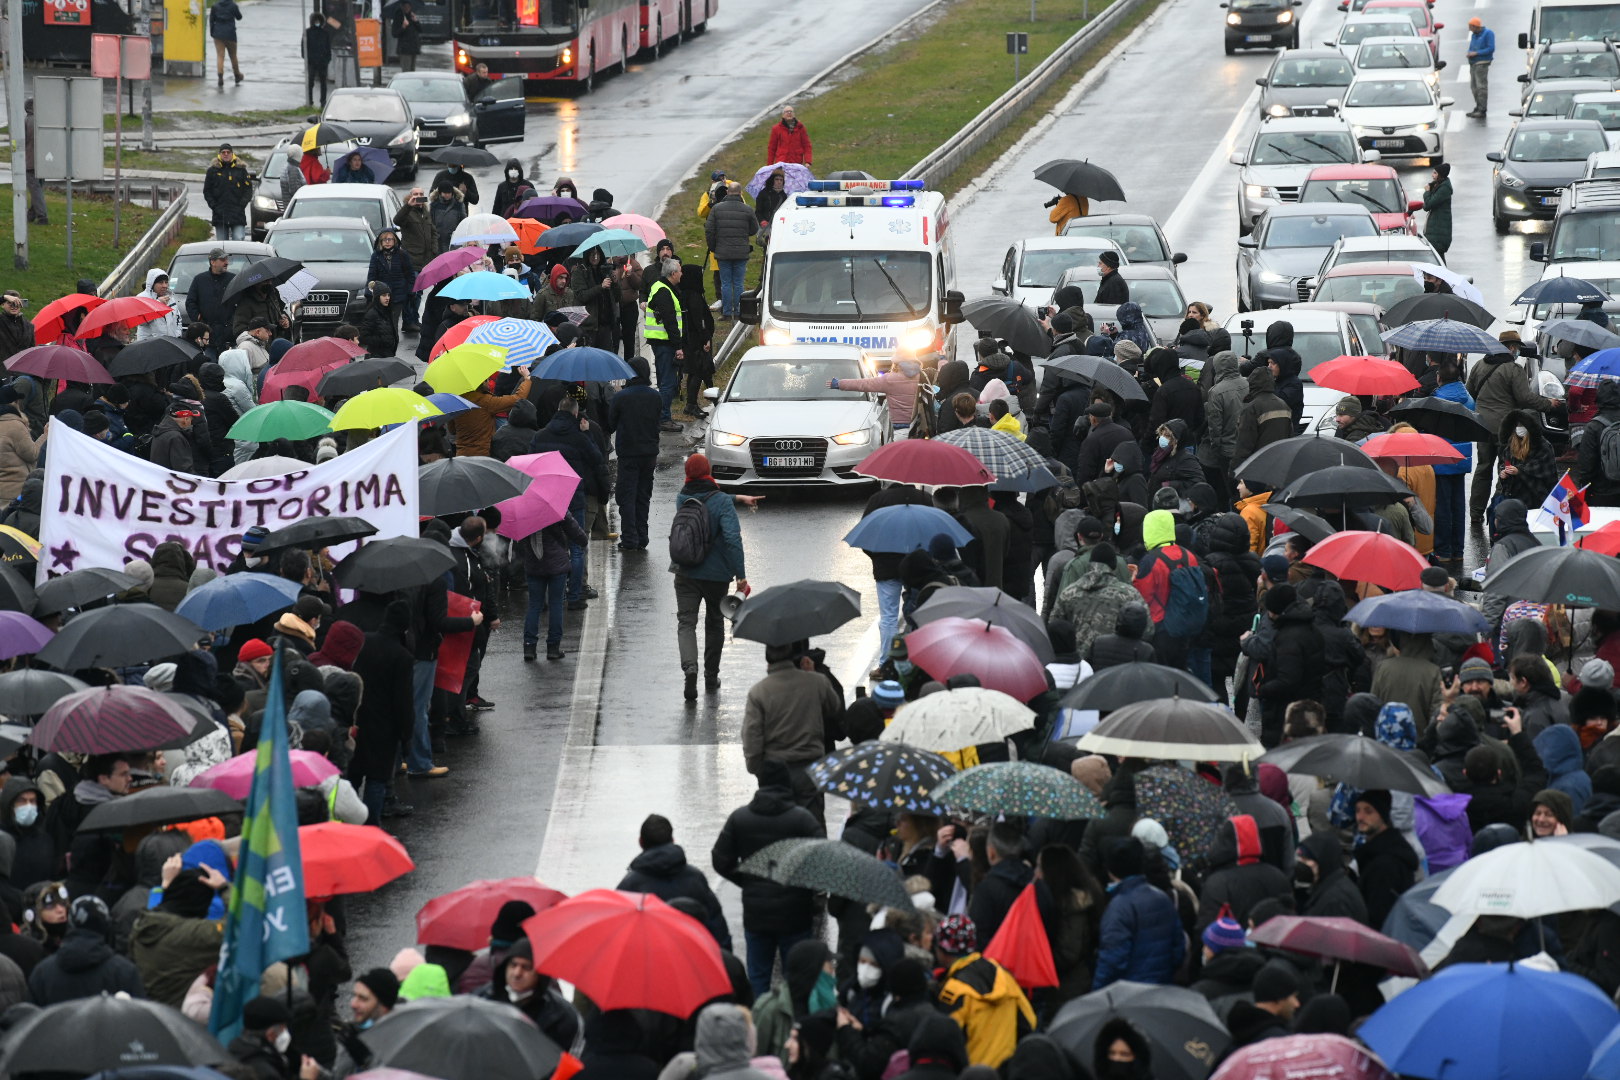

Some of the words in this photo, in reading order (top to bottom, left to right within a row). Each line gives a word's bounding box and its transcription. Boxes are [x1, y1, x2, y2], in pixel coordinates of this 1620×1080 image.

[769, 457, 778, 466] BG
[166, 471, 309, 495] STOP
[59, 474, 405, 528] INVESTITORIMA
